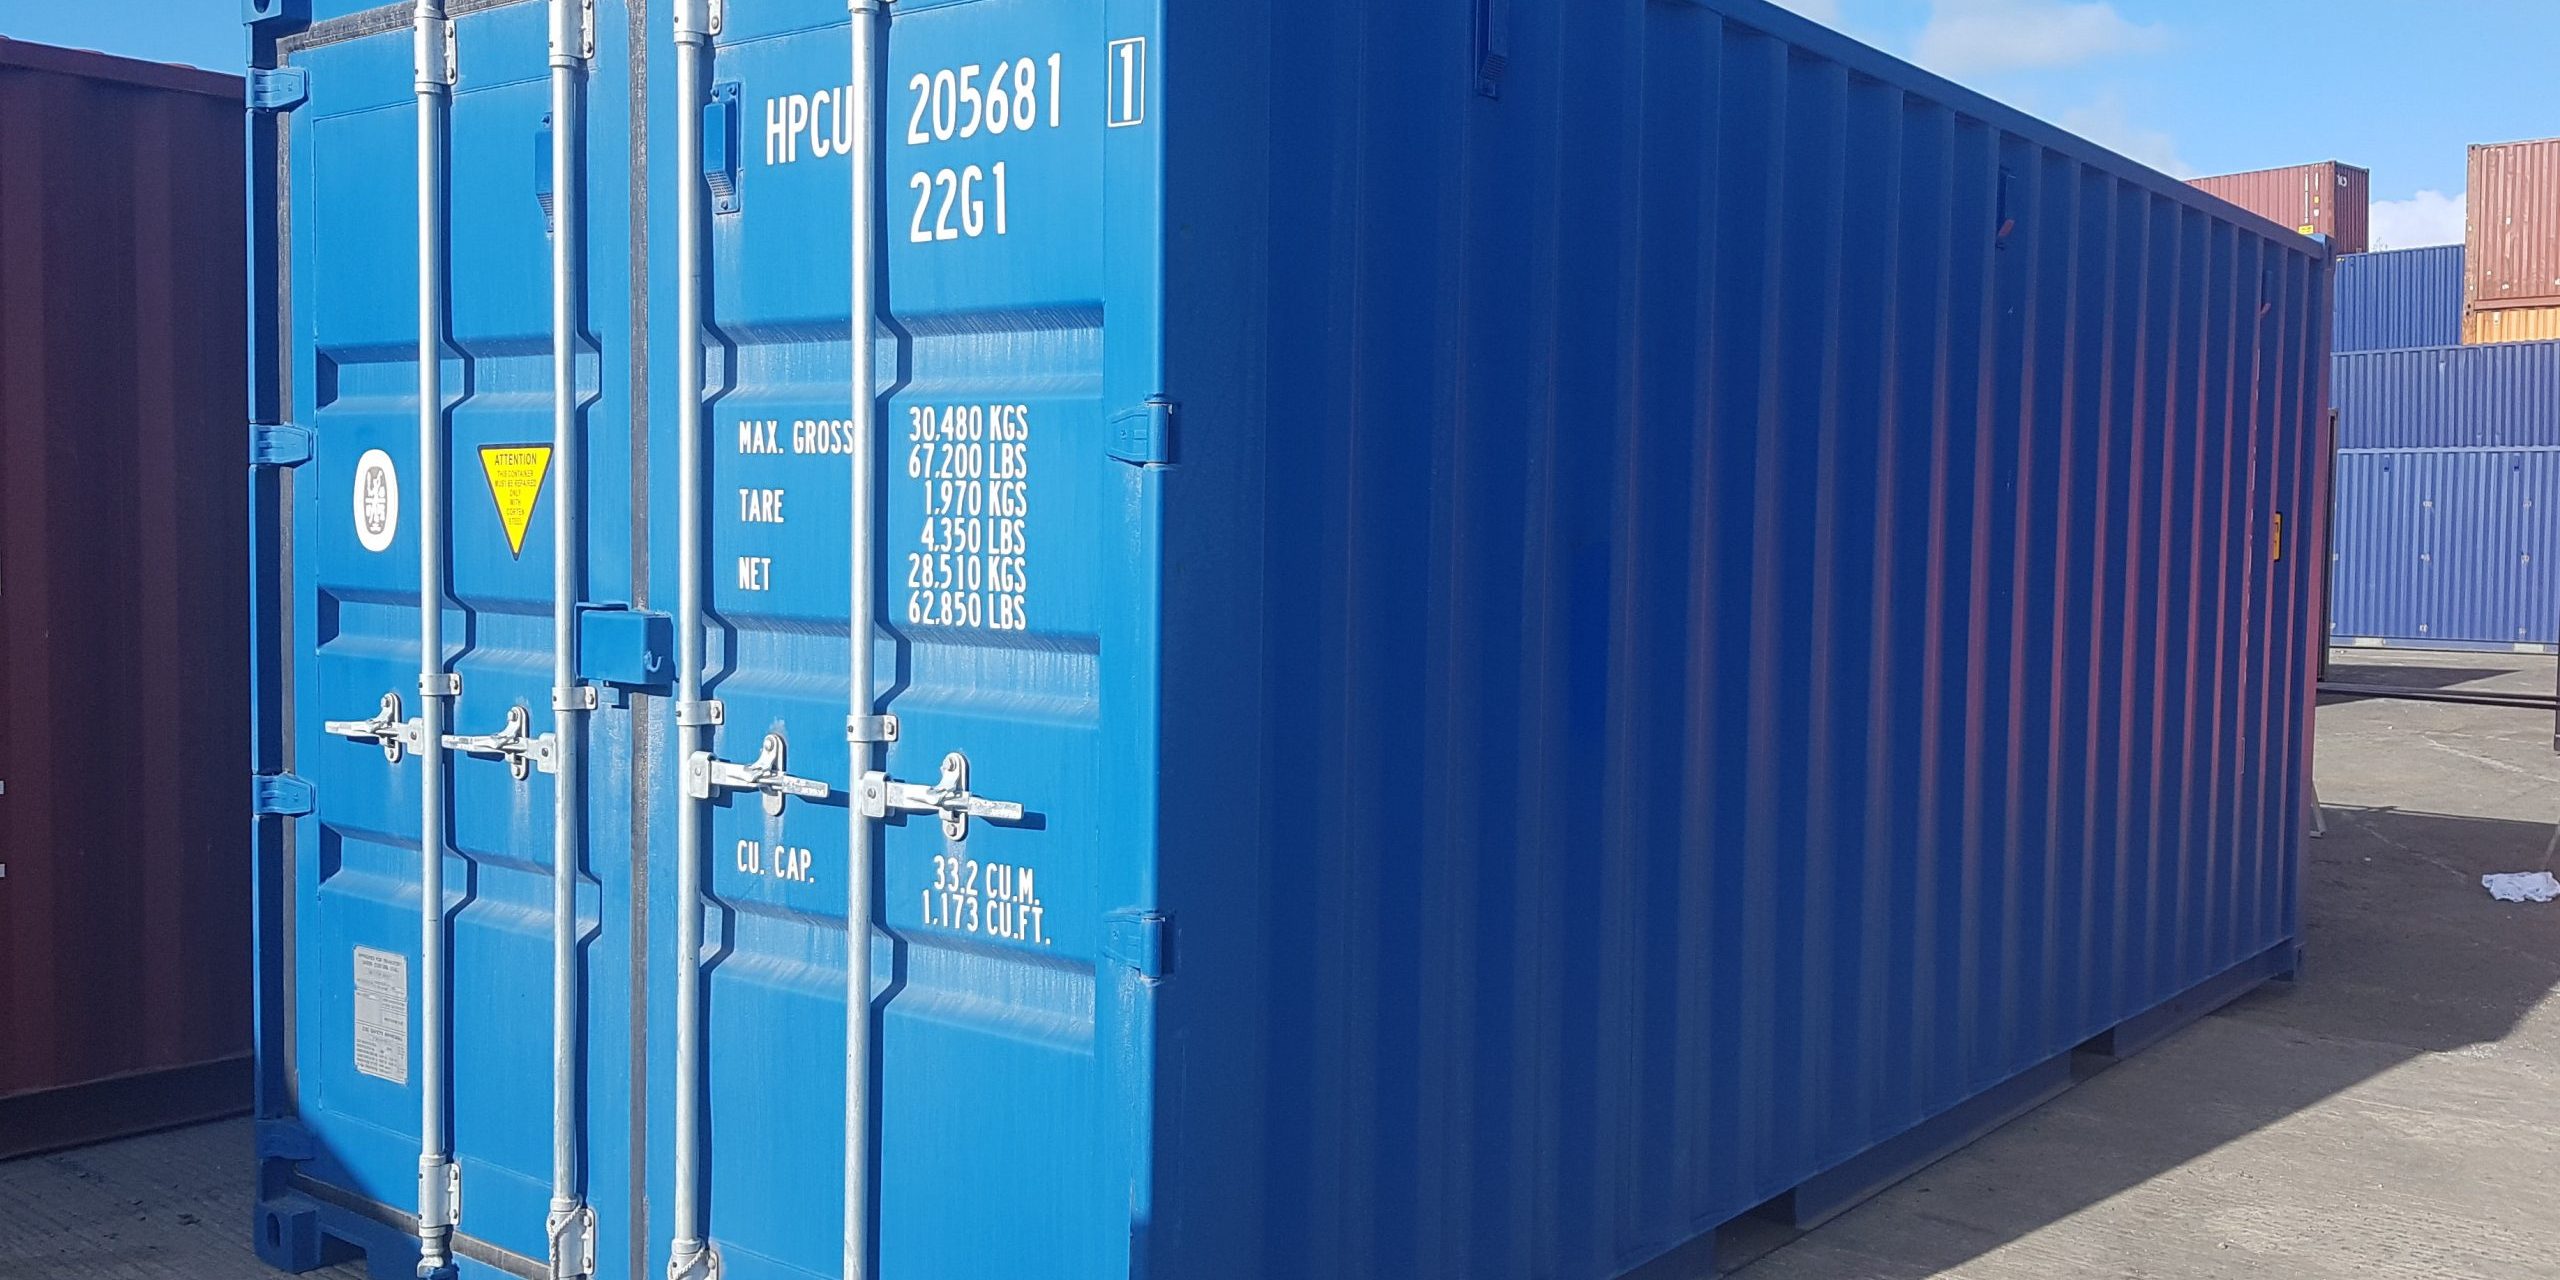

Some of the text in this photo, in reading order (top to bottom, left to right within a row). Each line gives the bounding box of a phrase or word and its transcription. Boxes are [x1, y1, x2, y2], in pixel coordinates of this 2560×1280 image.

[766, 43, 1134, 166] HPCU 205681 1
[910, 161, 1006, 243] 22G1
[738, 420, 784, 454] MAX.
[792, 420, 853, 455] GROSS
[989, 404, 1029, 442] KGS
[494, 453, 537, 466] ATTENTION
[989, 442, 1028, 480] LBS
[739, 488, 785, 523] TARE
[988, 480, 1028, 518] KGS
[988, 517, 1027, 555] LBS
[738, 556, 771, 591] NET
[988, 555, 1028, 593] KGS
[988, 592, 1027, 631] LBS
[737, 840, 1040, 906] CU. CAP. 33.2 CU.M.
[985, 899, 1051, 945] CU.FT.
